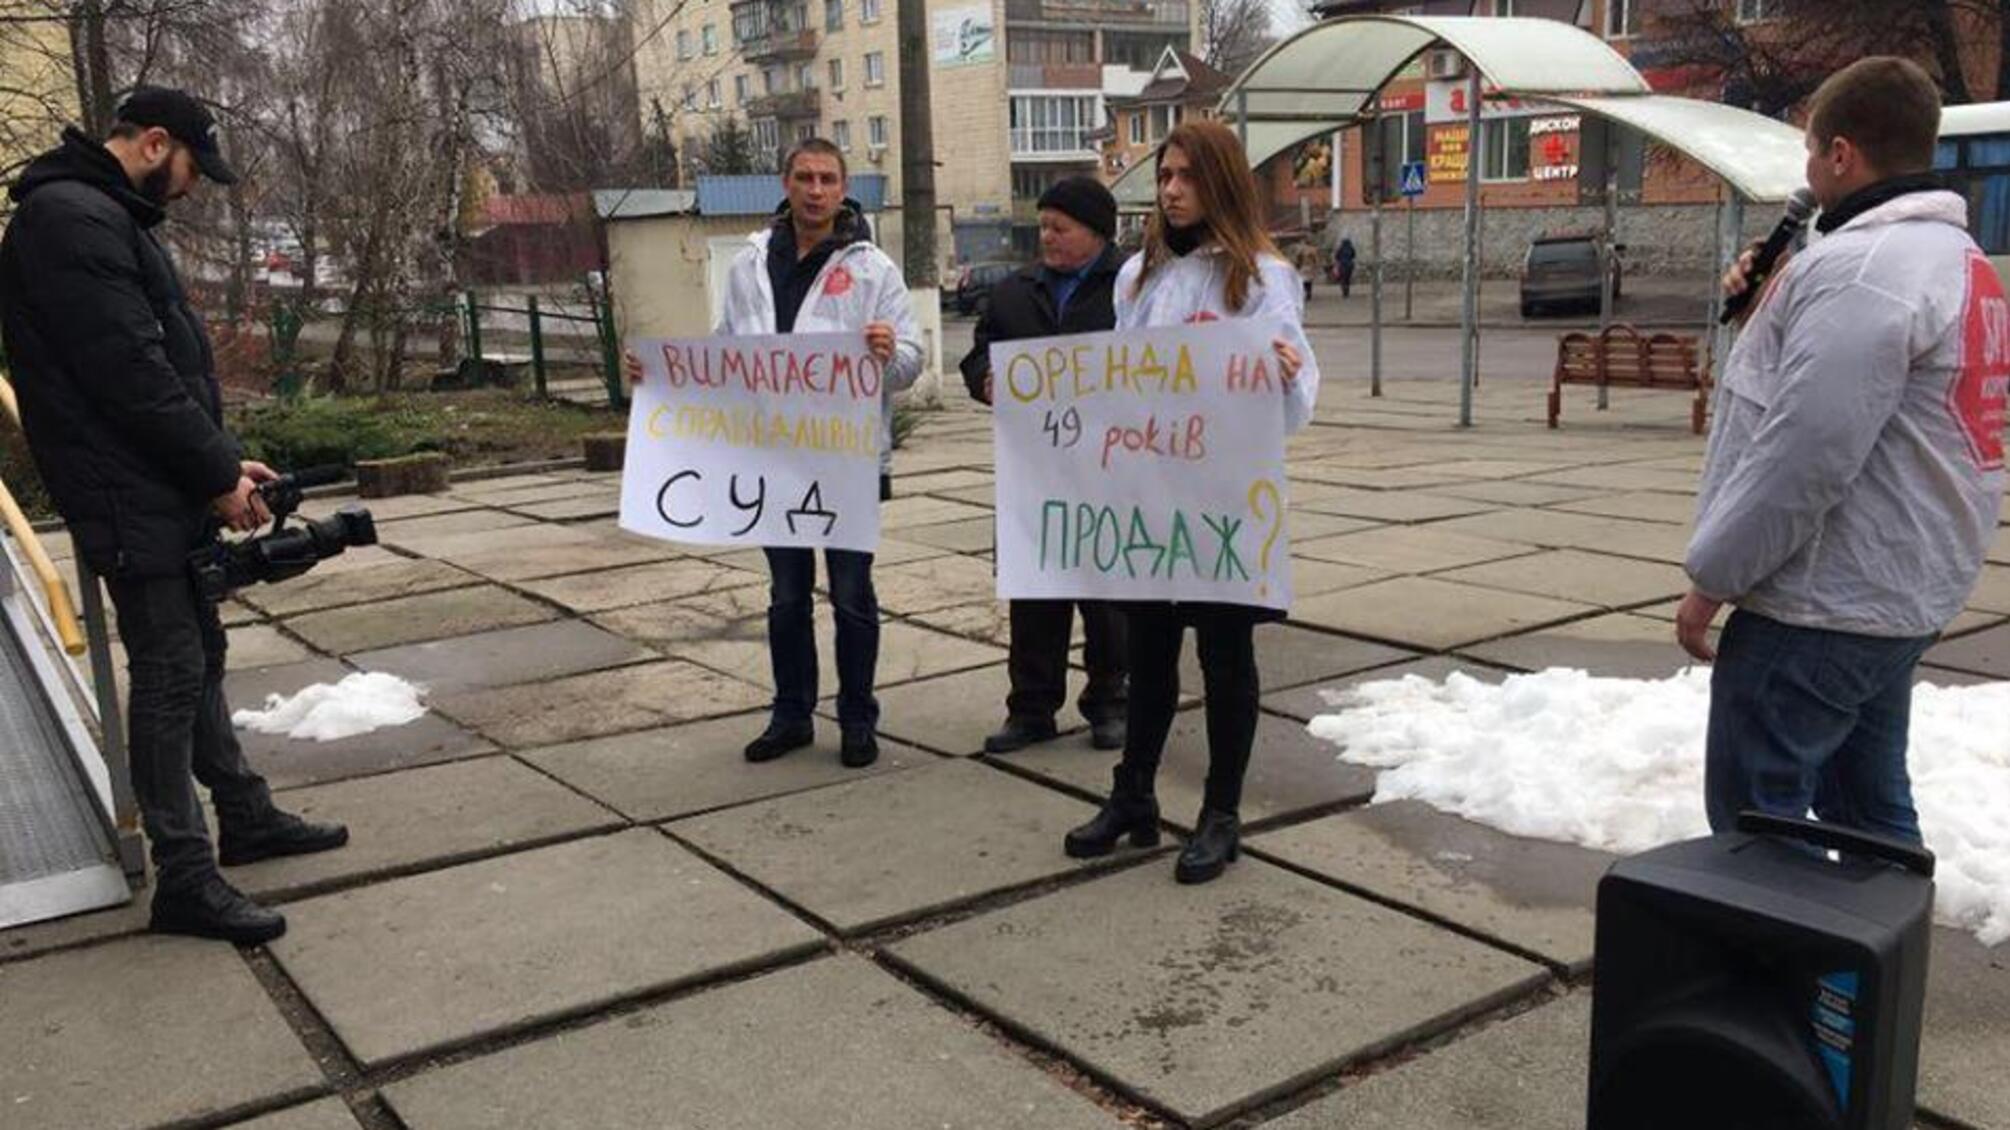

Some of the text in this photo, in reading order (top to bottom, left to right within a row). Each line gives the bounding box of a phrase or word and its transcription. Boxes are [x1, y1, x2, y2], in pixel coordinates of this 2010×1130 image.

[1533, 164, 1579, 180] ЦЕНТР
[662, 344, 880, 398] ВИМАГАЄМО
[1007, 342, 1273, 403] ОРЕНДА НА
[1043, 405, 1083, 448] 49
[656, 469, 838, 536] СУД
